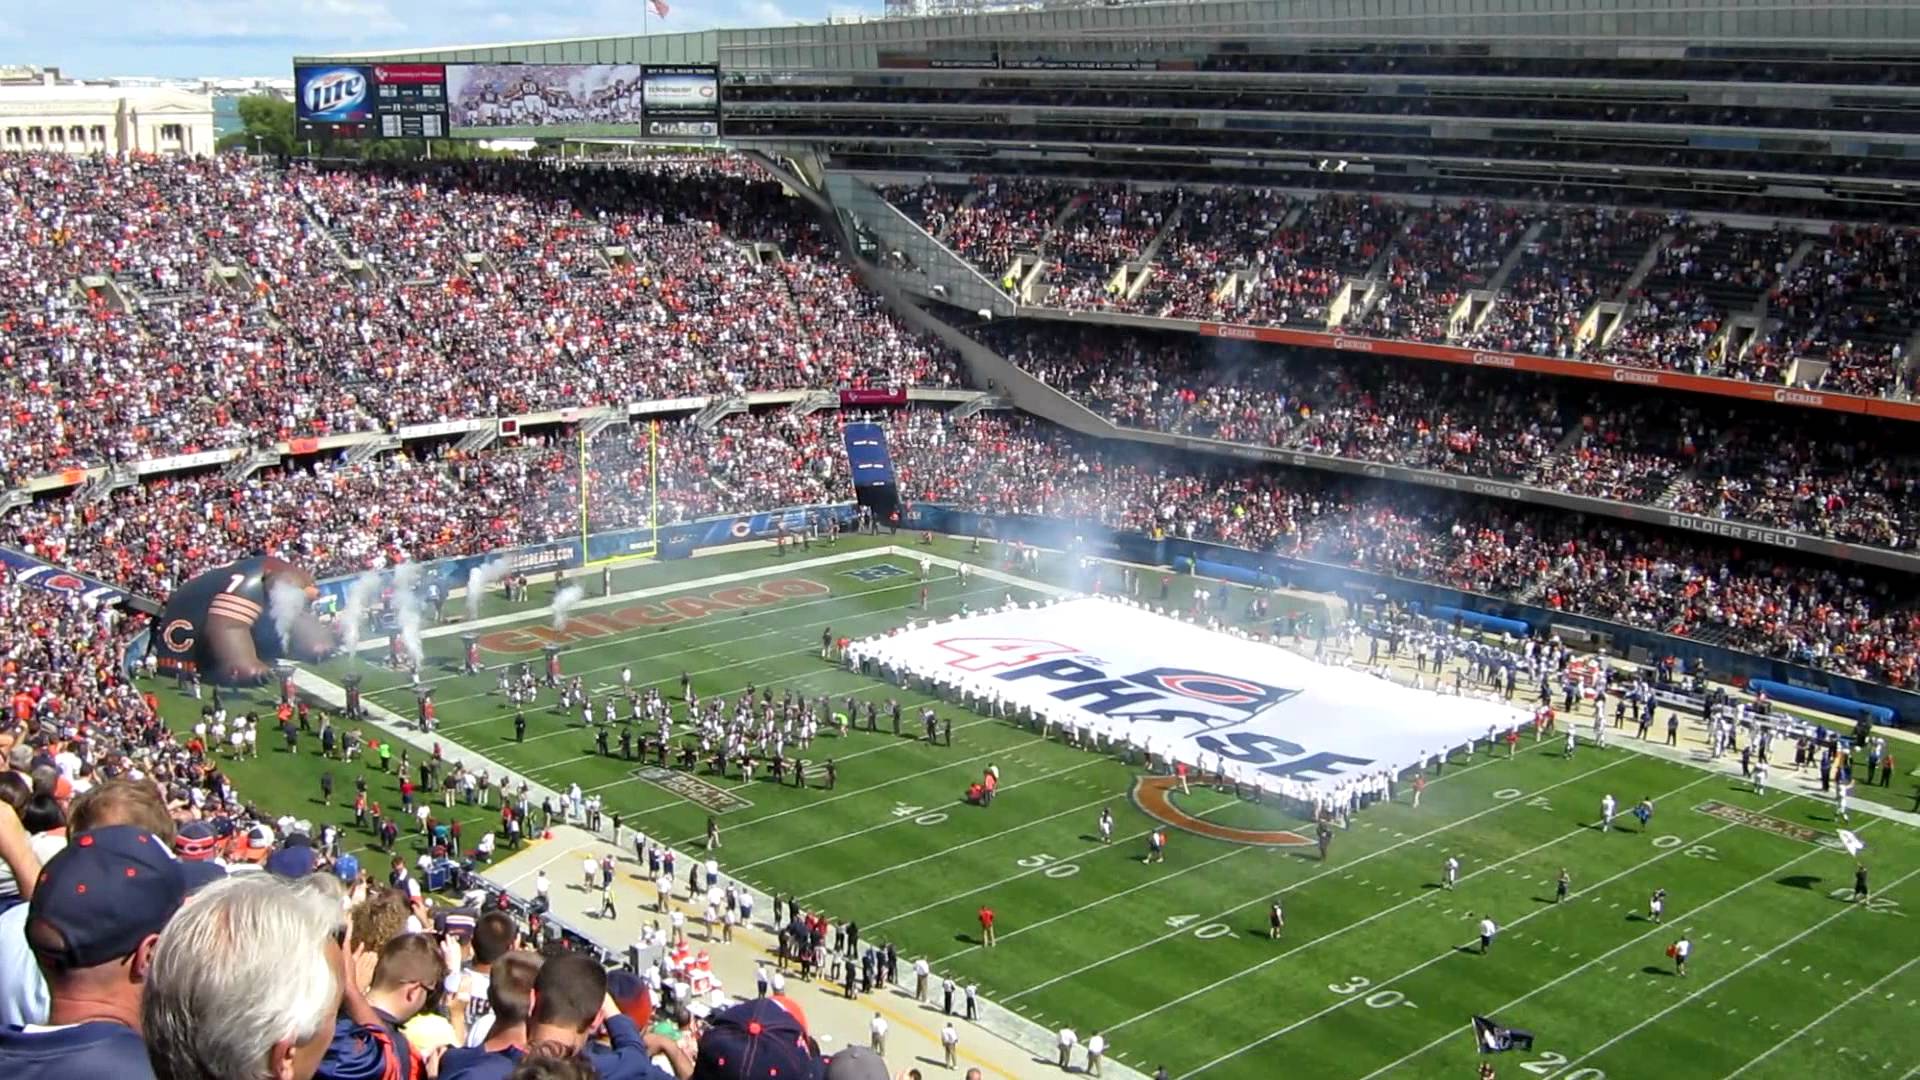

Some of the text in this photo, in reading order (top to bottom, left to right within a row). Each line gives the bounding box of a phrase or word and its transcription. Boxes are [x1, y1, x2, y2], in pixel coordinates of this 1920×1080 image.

[649, 121, 698, 135] CHASE
[1474, 483, 1509, 497] CHASE
[1669, 515, 1797, 548] SOLDIER FIELD
[478, 579, 831, 653] CHICAGO
[933, 638, 1083, 672] 4
[891, 800, 949, 825] 40
[1017, 853, 1080, 878] 50
[1165, 914, 1231, 939] 40
[1328, 976, 1405, 1009] 30
